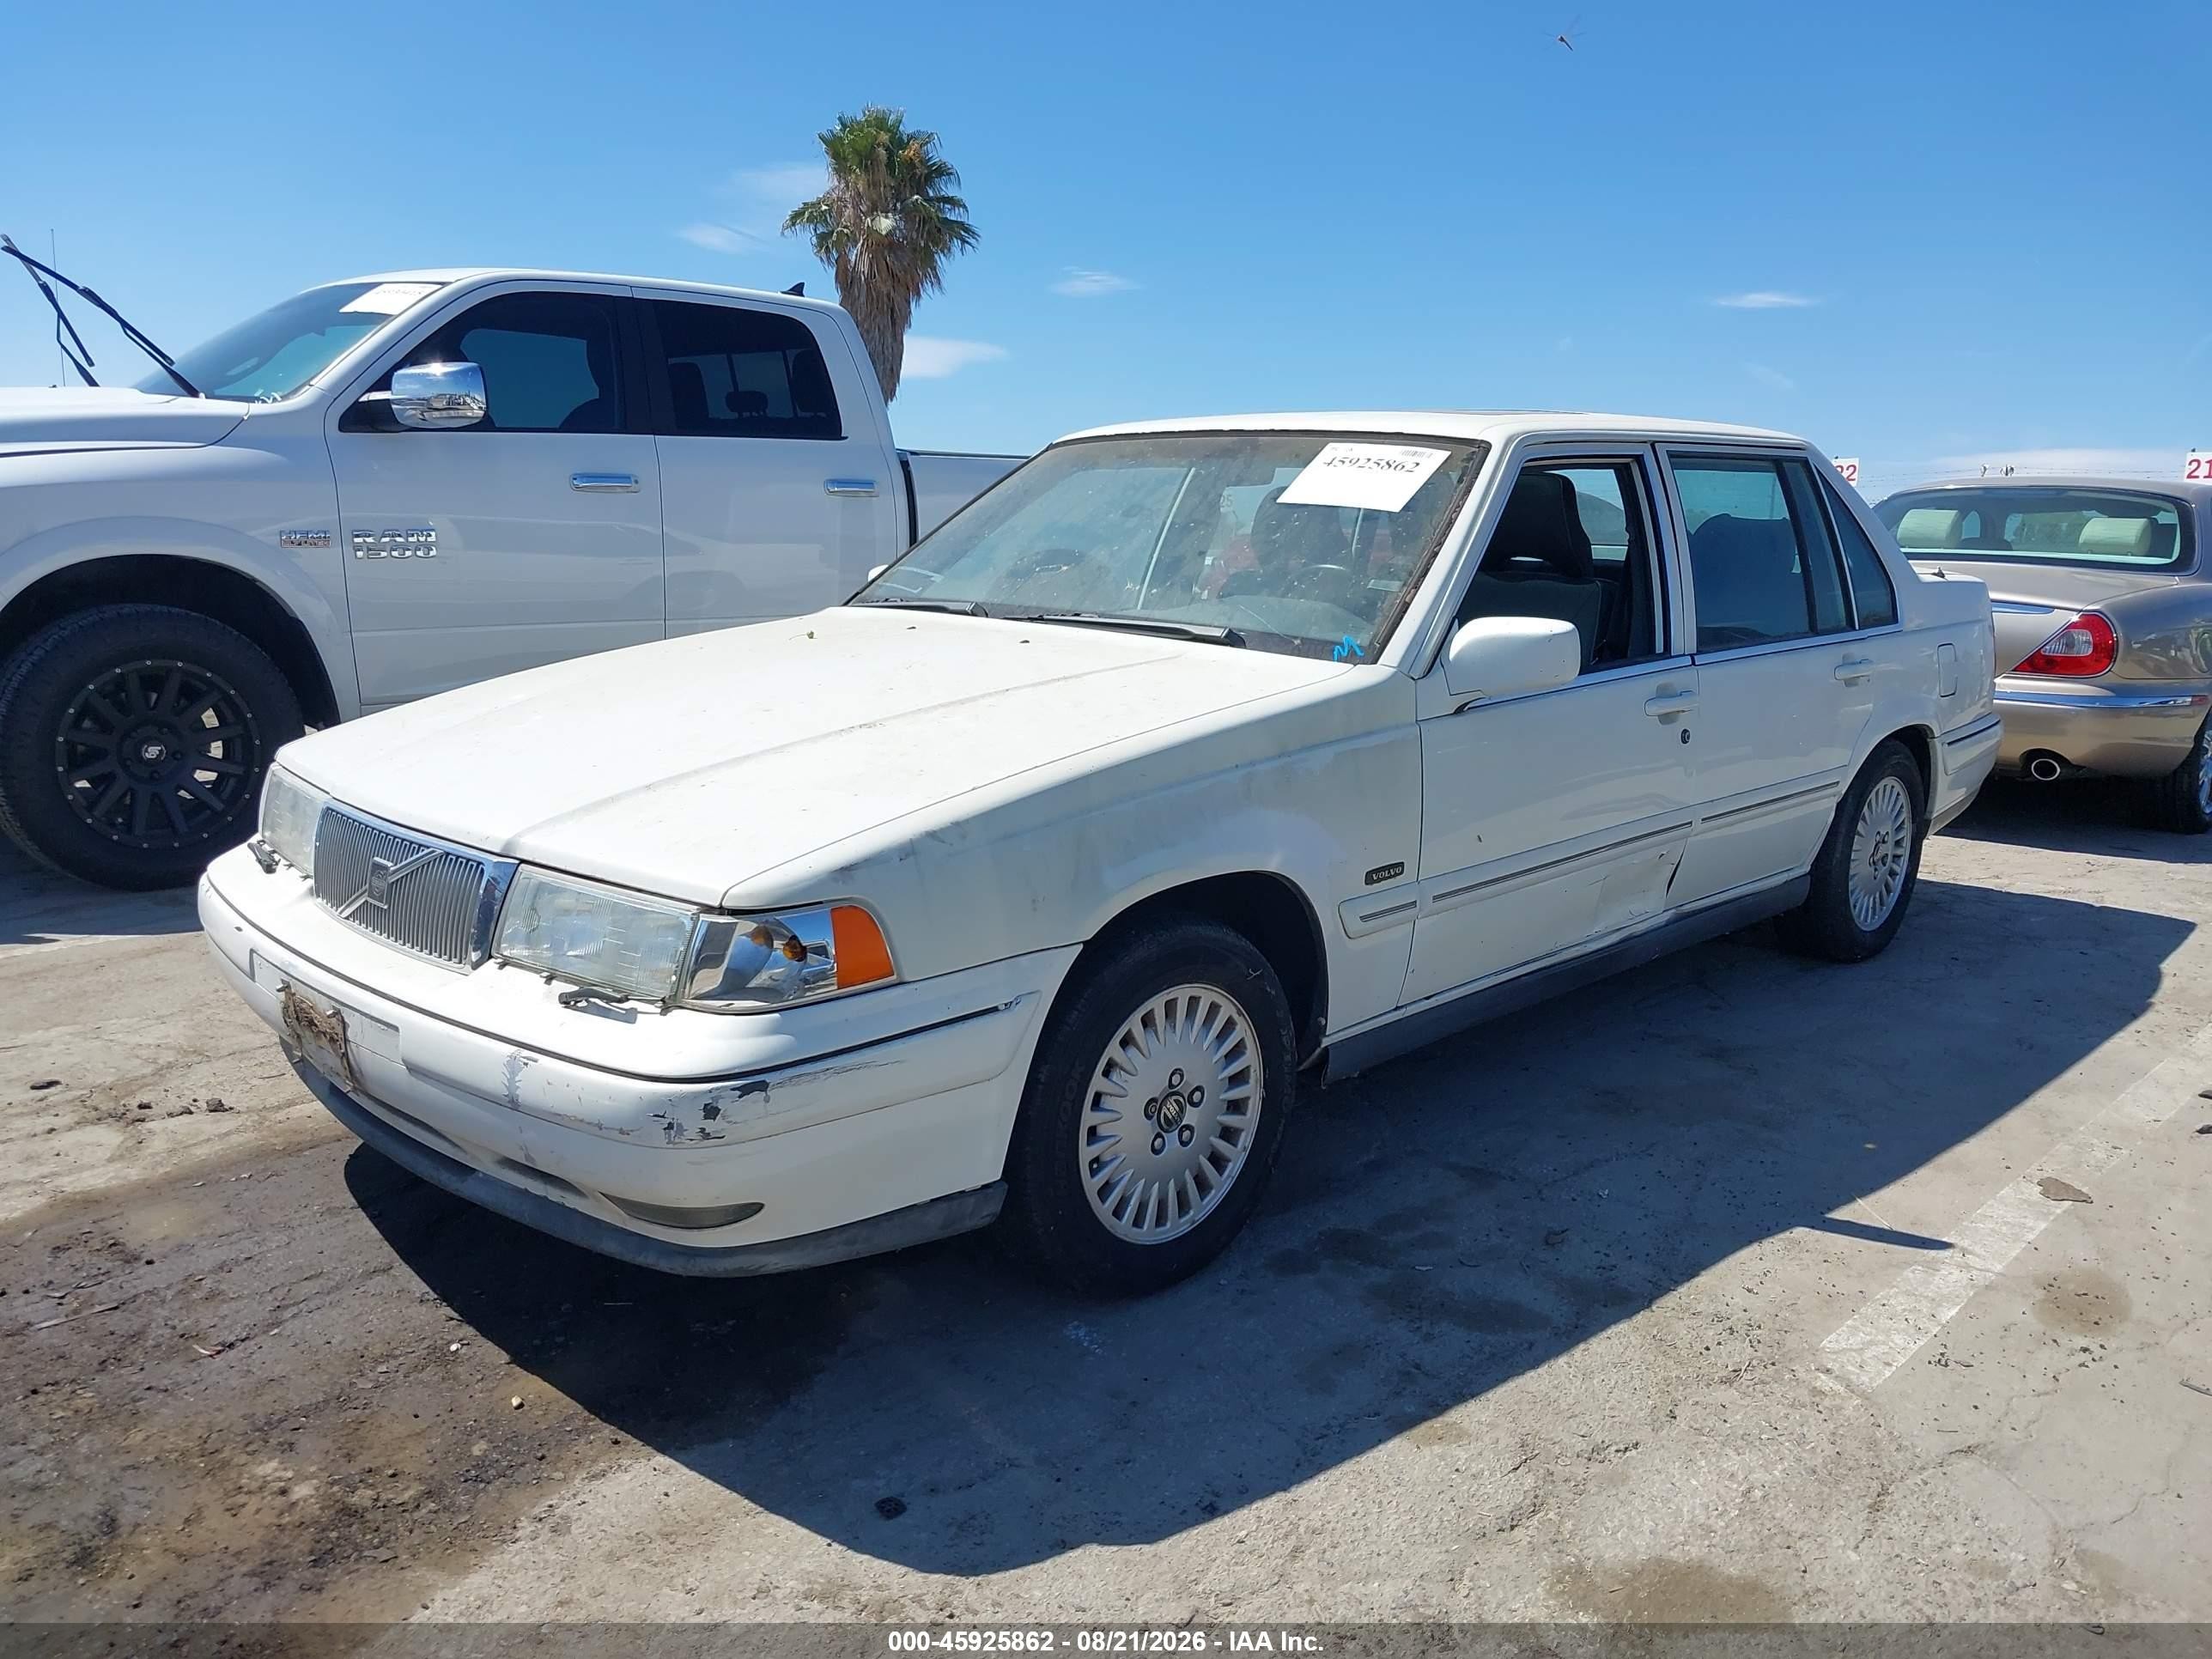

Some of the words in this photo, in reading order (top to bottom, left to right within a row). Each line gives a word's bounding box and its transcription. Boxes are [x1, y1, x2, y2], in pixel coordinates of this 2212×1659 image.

[1323, 456, 1420, 472] 45925862
[352, 530, 437, 543] RAM
[354, 545, 437, 558] 1500
[1372, 866, 1402, 880] VOLVO
